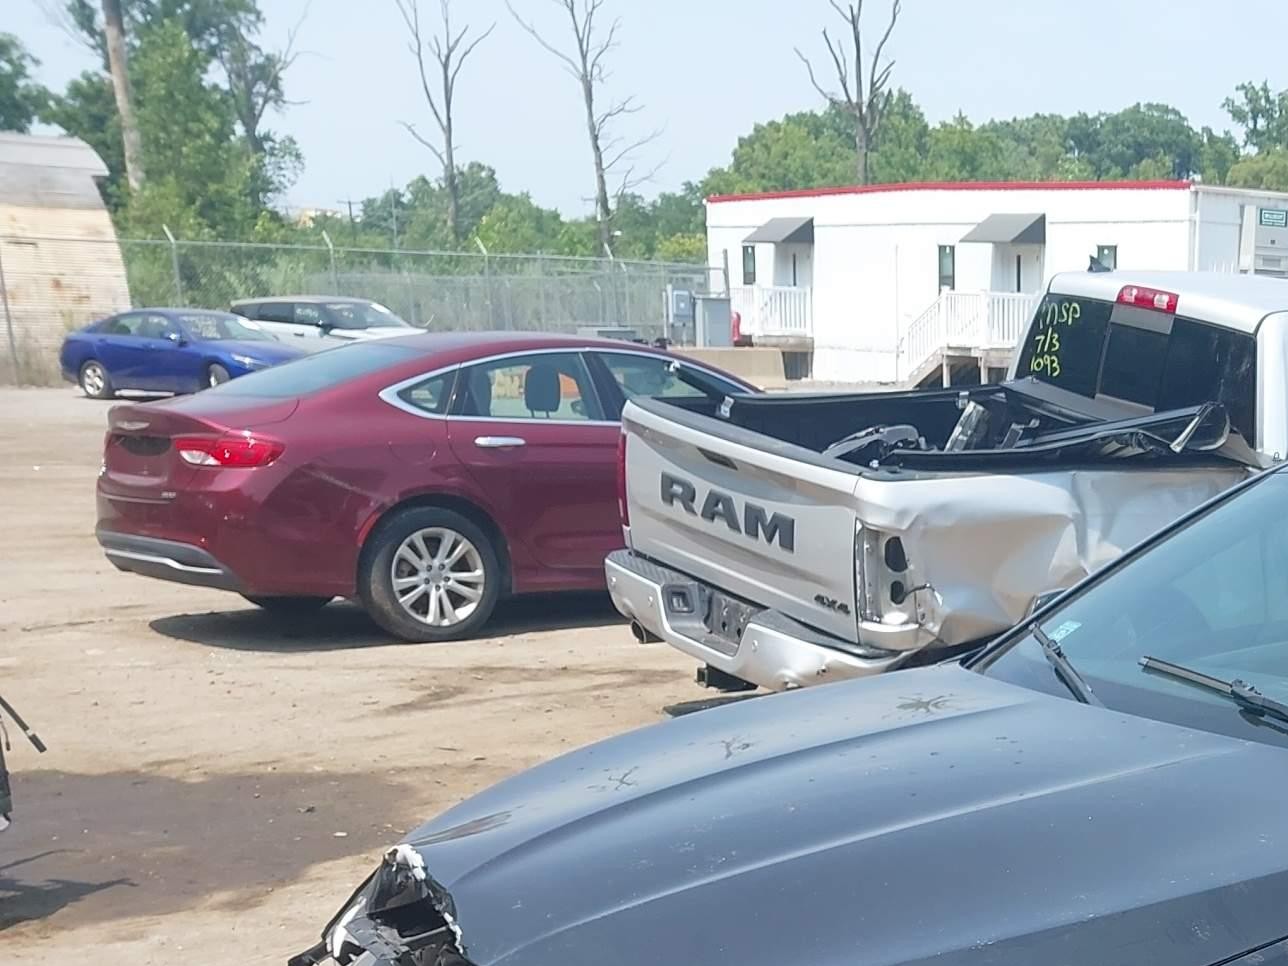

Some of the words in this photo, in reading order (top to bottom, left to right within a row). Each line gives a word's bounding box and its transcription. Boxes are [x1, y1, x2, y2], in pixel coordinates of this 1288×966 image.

[1035, 327, 1060, 354] 7/3
[1031, 354, 1061, 377] 1093
[661, 471, 796, 554] RAM
